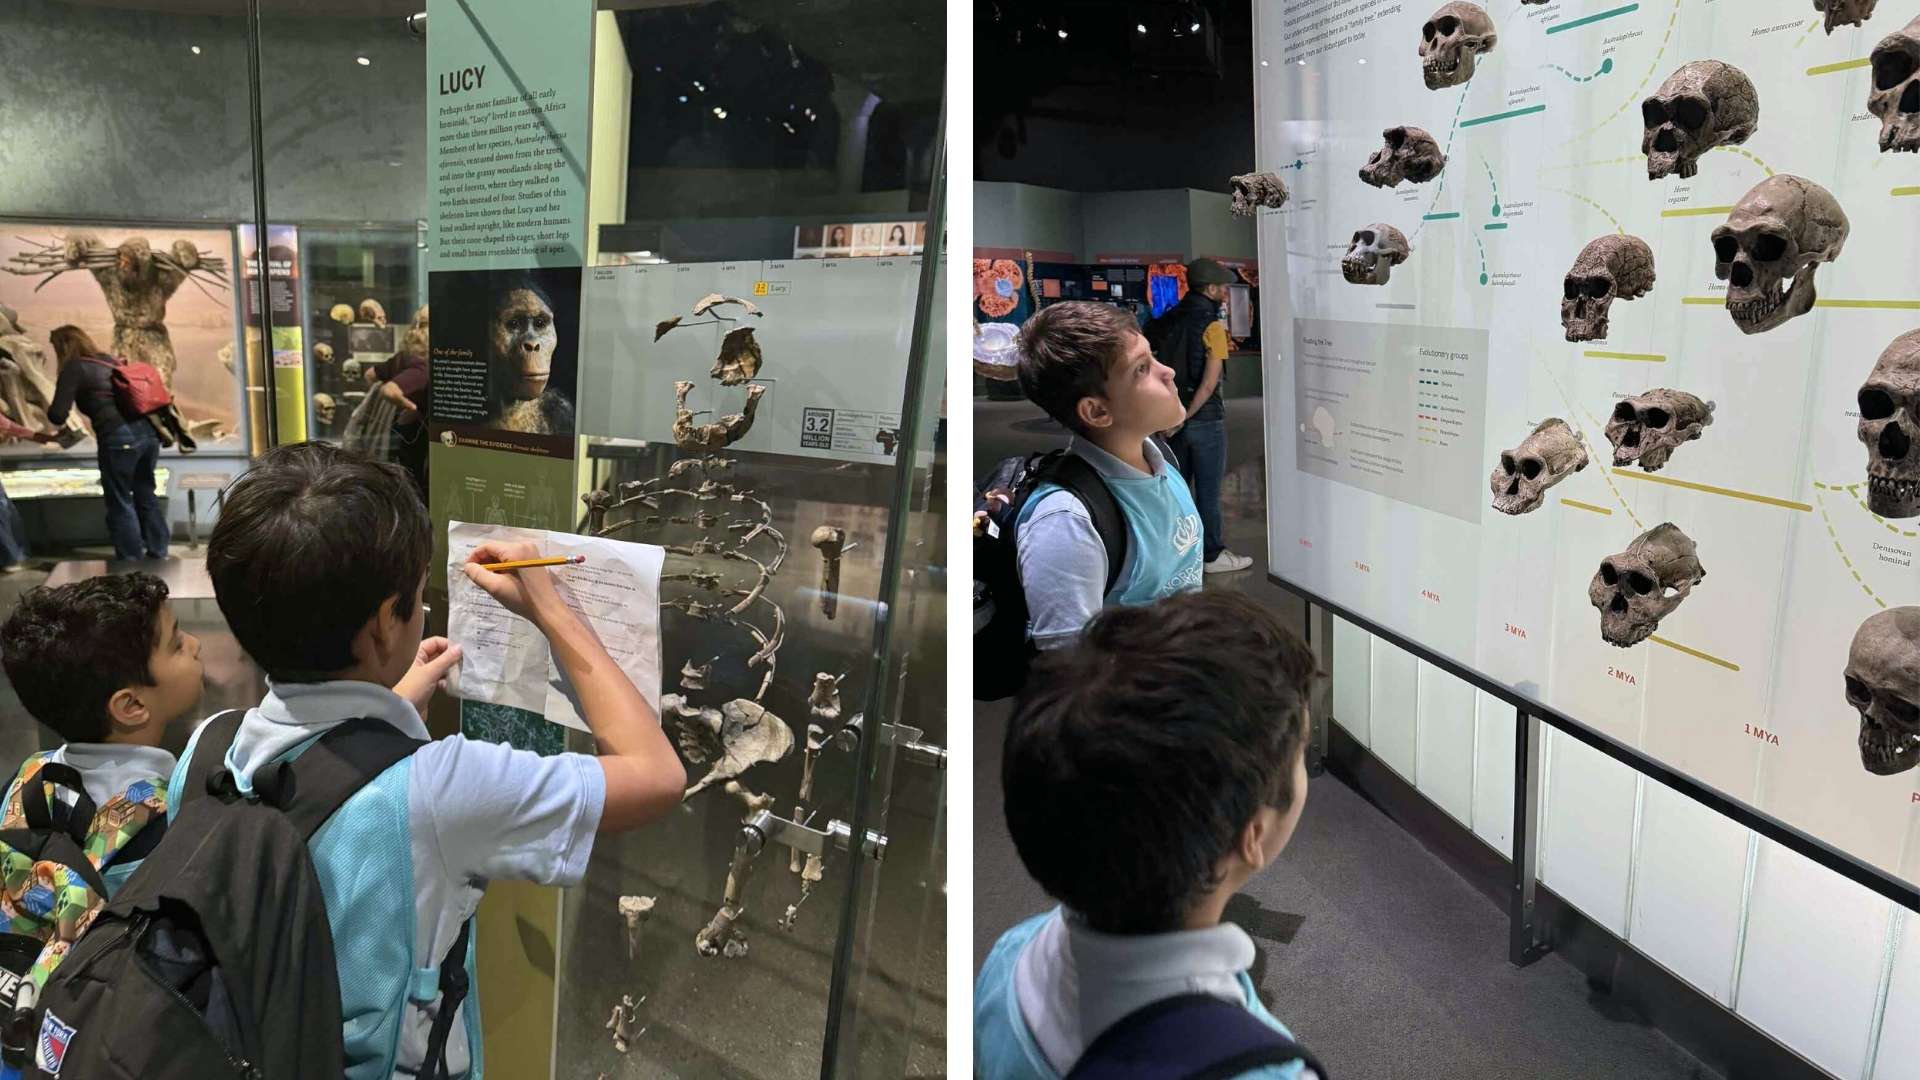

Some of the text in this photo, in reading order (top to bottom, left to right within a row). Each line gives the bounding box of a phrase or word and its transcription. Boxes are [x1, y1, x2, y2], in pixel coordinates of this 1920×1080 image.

[1752, 20, 1804, 36] Homo antecessor
[440, 65, 486, 95] LUCY
[440, 106, 462, 117] Perhaps
[464, 102, 474, 111] the
[476, 101, 491, 109] most
[493, 96, 518, 106] familiar
[539, 88, 557, 99] early
[493, 111, 508, 120] lived
[544, 103, 566, 112] Africa
[456, 131, 470, 140] than
[490, 125, 512, 135] million
[514, 122, 531, 132] years
[469, 144, 476, 152] of
[495, 152, 513, 160] down
[516, 150, 531, 159] from
[534, 148, 544, 156] the
[465, 170, 475, 178] the
[477, 169, 495, 180] grassy
[497, 164, 531, 174] woodlands
[534, 162, 552, 172] along
[554, 160, 565, 168] the
[488, 181, 507, 189] where
[509, 180, 523, 188] they
[525, 174, 549, 185] walked
[518, 190, 542, 200] Studies
[544, 188, 552, 198] of
[554, 187, 566, 196] this
[503, 206, 515, 215] that
[518, 206, 533, 218] Lucy
[535, 203, 547, 212] and
[549, 202, 560, 212] her
[503, 220, 515, 228] like
[517, 218, 542, 227] modern
[506, 233, 515, 241] rib
[537, 232, 555, 240] short
[557, 230, 570, 241] legs
[488, 246, 520, 256] resembled
[521, 246, 539, 255] those
[1420, 348, 1449, 359] Evolutionary
[806, 417, 829, 432] 3.2
[1873, 542, 1912, 558] Denisovan
[1878, 554, 1911, 567] hominid
[1422, 589, 1440, 603] 4 MYA
[1504, 623, 1526, 639] 3 MYA
[1608, 666, 1636, 686] 2 MYA
[1744, 724, 1779, 746] 1 MYA
